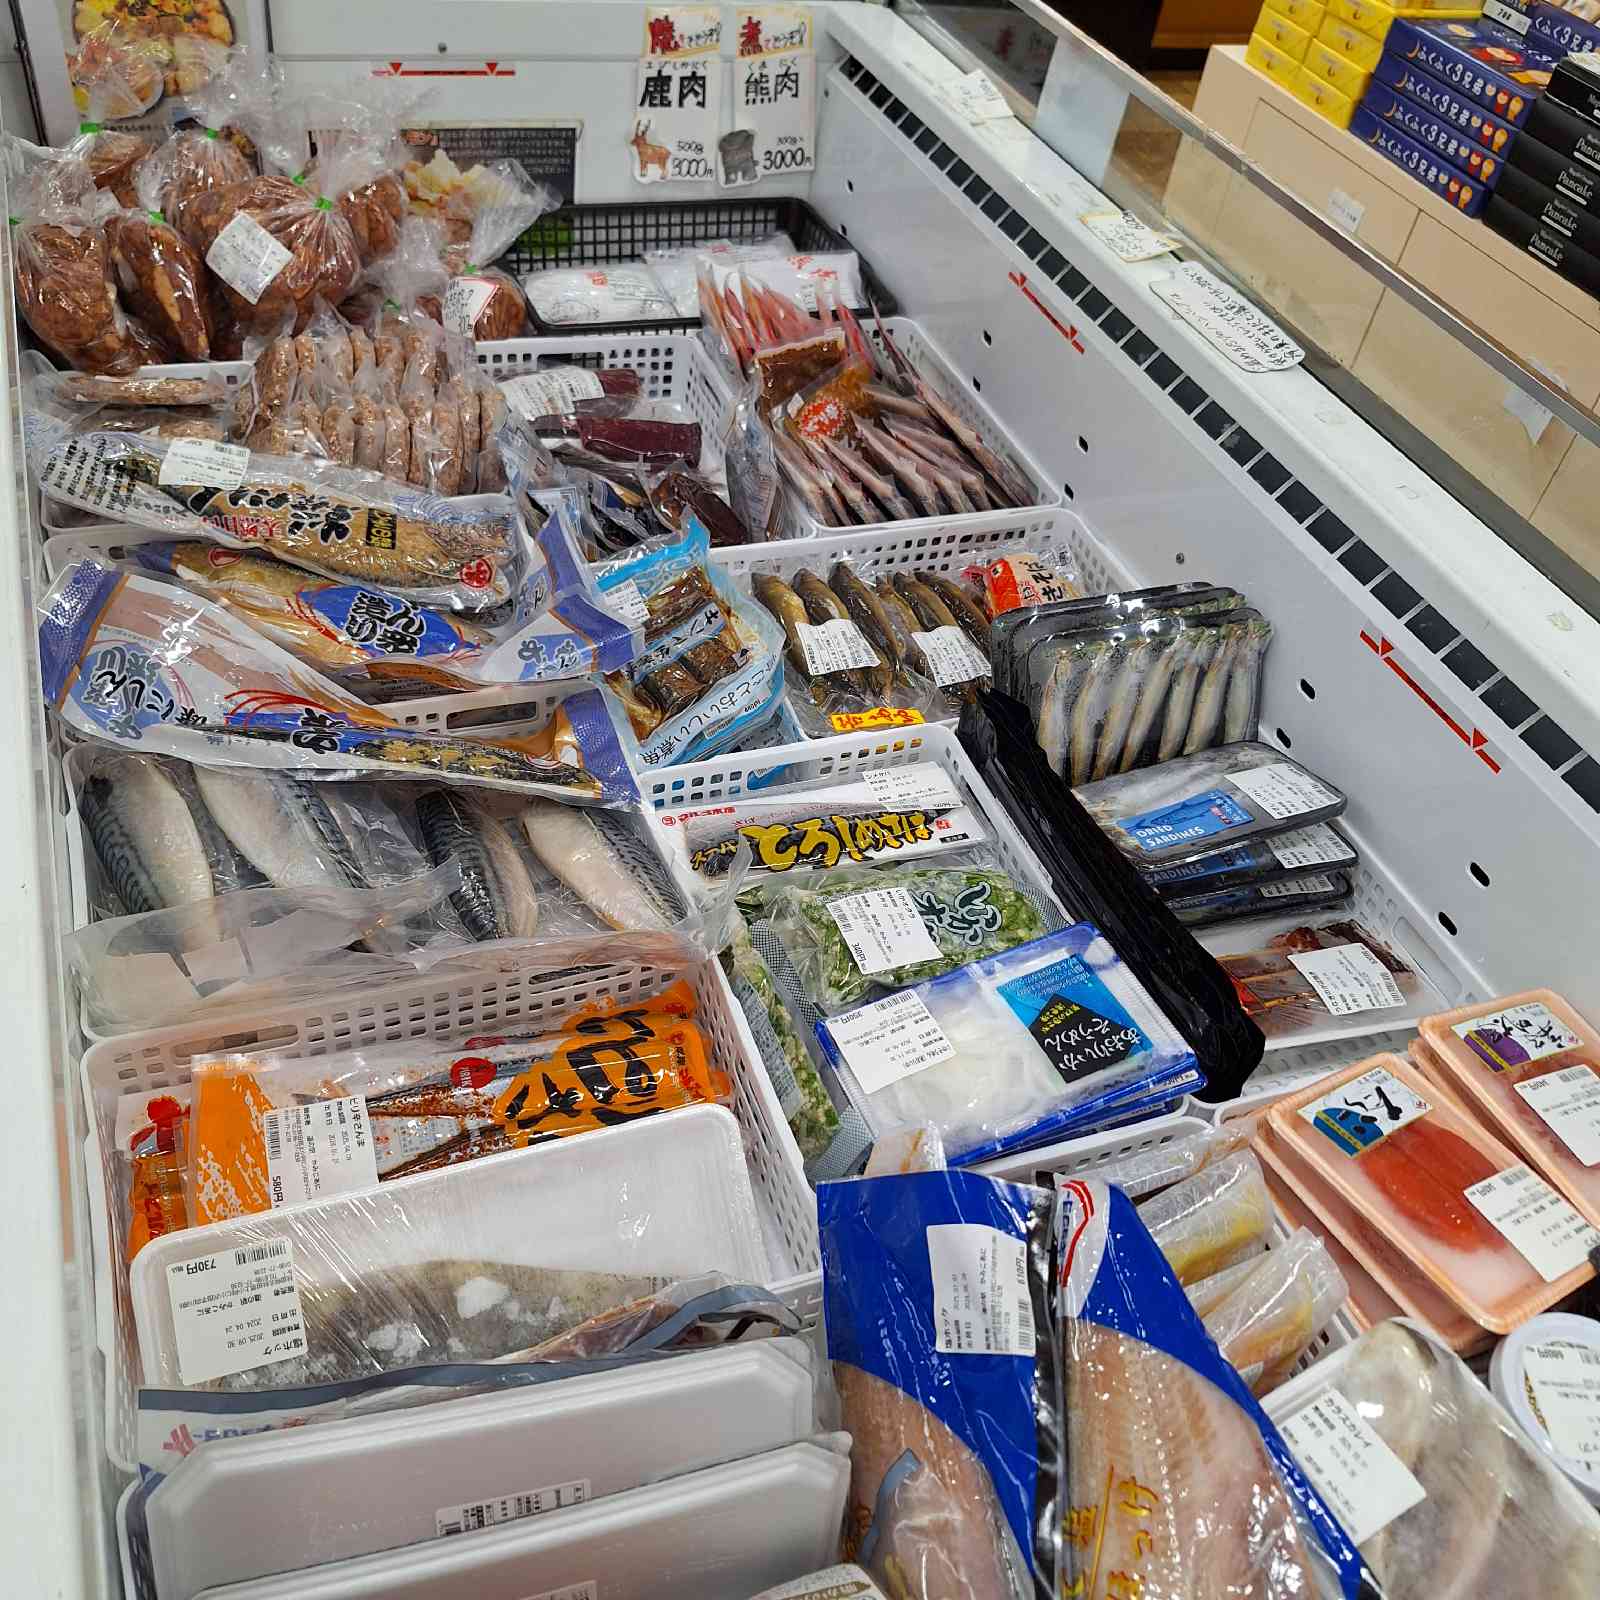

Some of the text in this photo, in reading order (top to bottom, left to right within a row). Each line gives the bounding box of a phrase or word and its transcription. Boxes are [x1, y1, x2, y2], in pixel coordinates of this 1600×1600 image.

[639, 69, 706, 109] 鹿肉
[745, 66, 799, 105] 熊肉
[1136, 824, 1174, 840] DRIED
[1145, 825, 1206, 848] SARDINES
[1044, 1018, 1110, 1050] そうめん
[1058, 1028, 1139, 1071] あおりいか
[349, 1097, 365, 1147] ピリ辛さんま
[271, 1176, 283, 1202] 580円
[186, 1258, 215, 1274] 730円
[197, 1301, 232, 1316] かみこあに
[240, 1294, 261, 1306] 道の駅
[264, 1338, 302, 1355] 塩ホッケ
